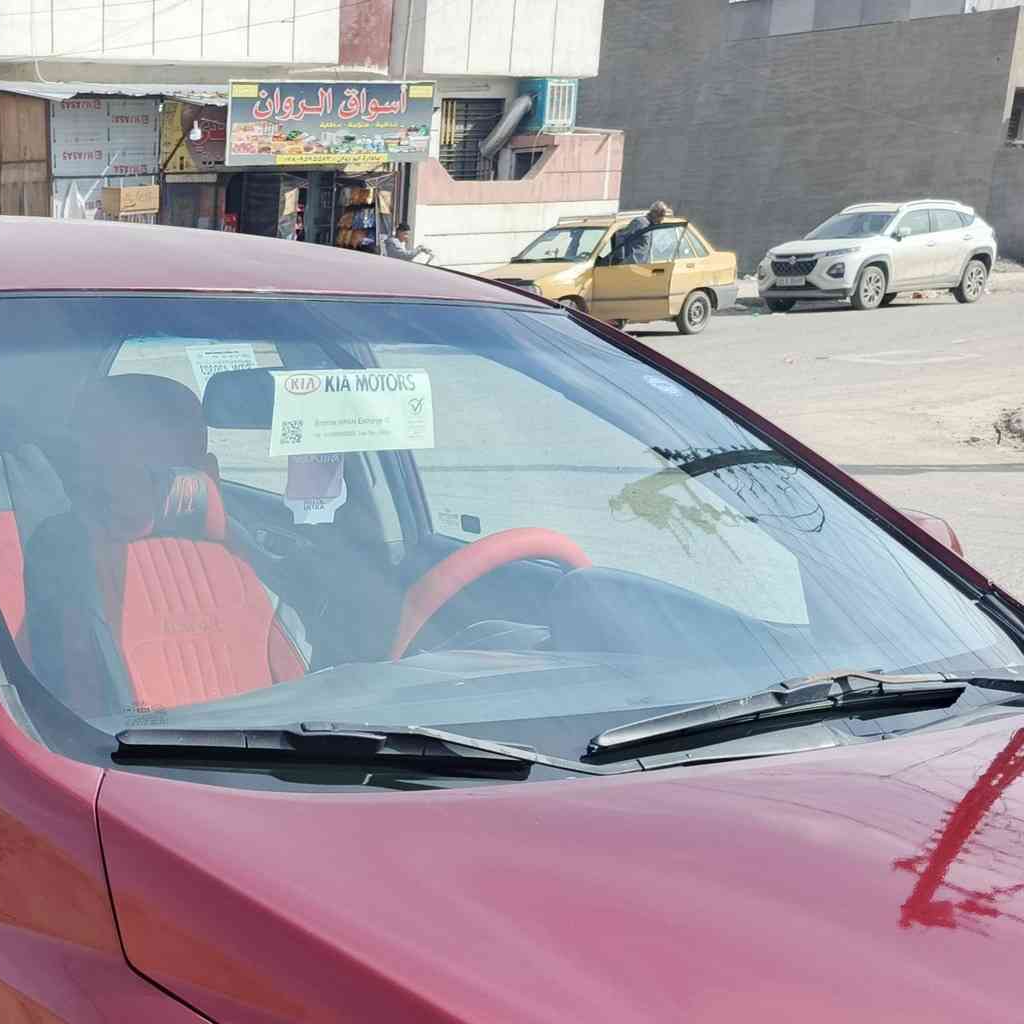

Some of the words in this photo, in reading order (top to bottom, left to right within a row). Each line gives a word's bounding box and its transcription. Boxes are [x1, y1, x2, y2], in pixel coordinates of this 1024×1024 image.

[291, 376, 315, 392] KIA
[325, 375, 350, 393] KIA
[356, 373, 417, 393] MOTORS
